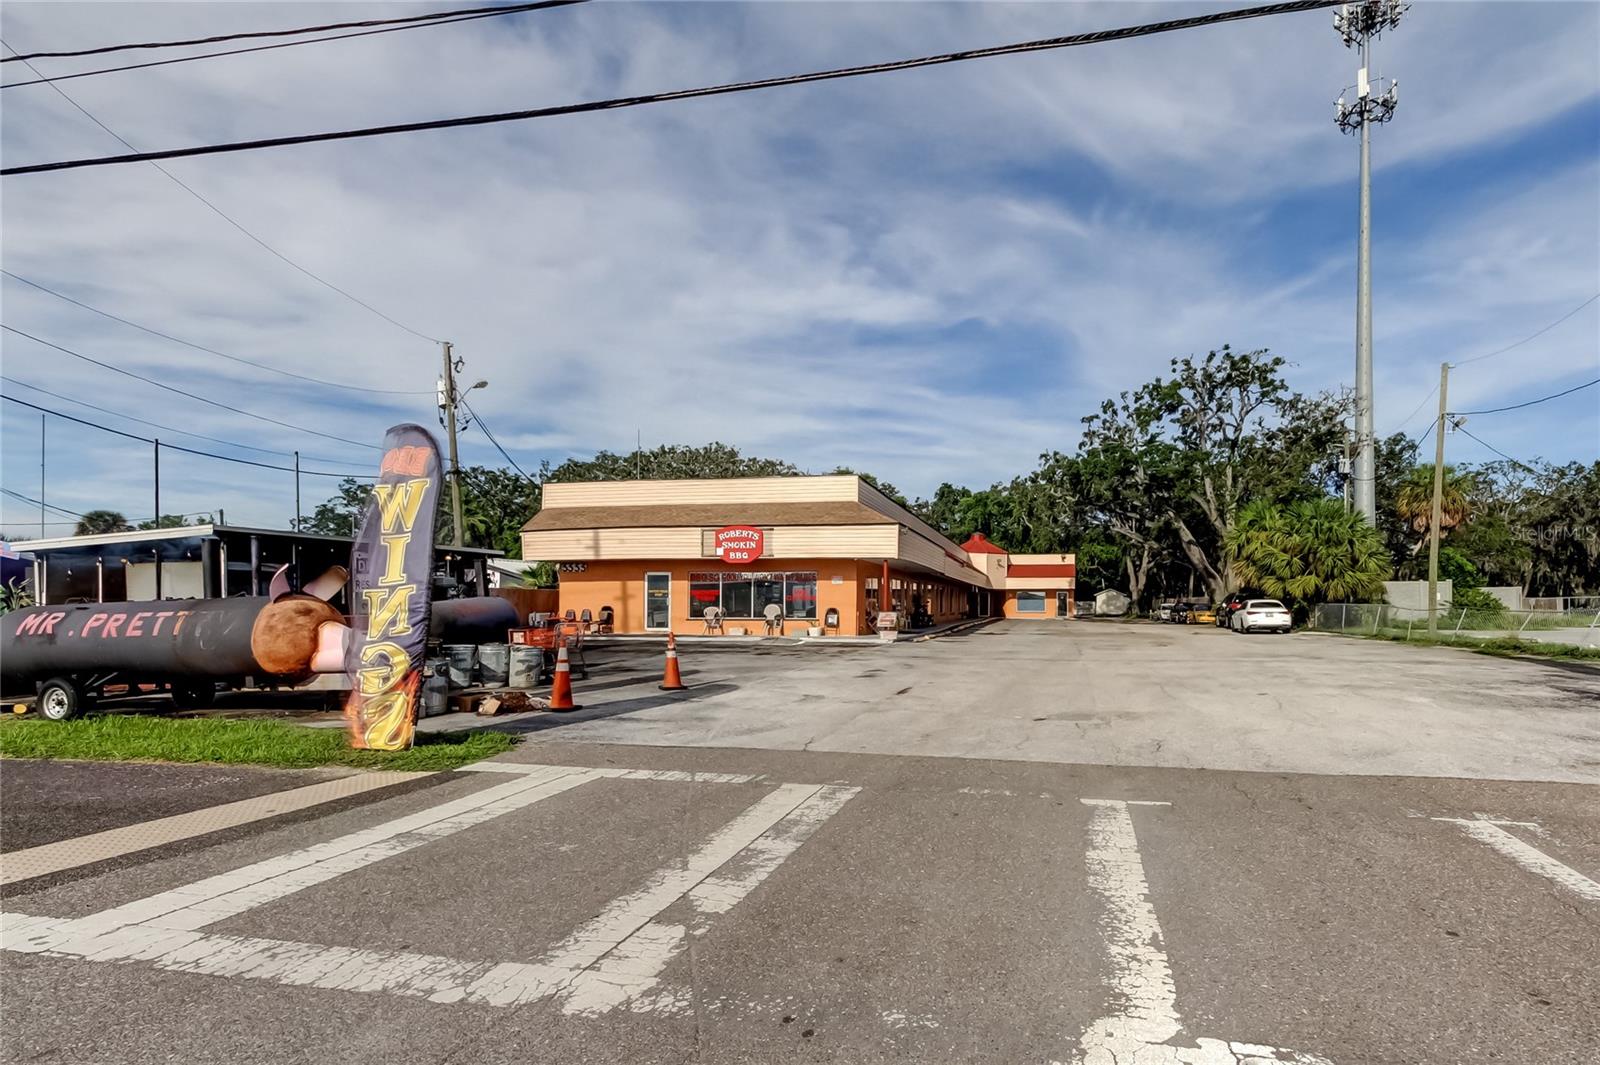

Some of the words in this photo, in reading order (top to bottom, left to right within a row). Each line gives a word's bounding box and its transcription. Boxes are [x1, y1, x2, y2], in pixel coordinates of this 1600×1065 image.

[719, 529, 760, 541] ROBERTS
[722, 541, 756, 549] SMOKIN
[729, 551, 749, 560] BBQ
